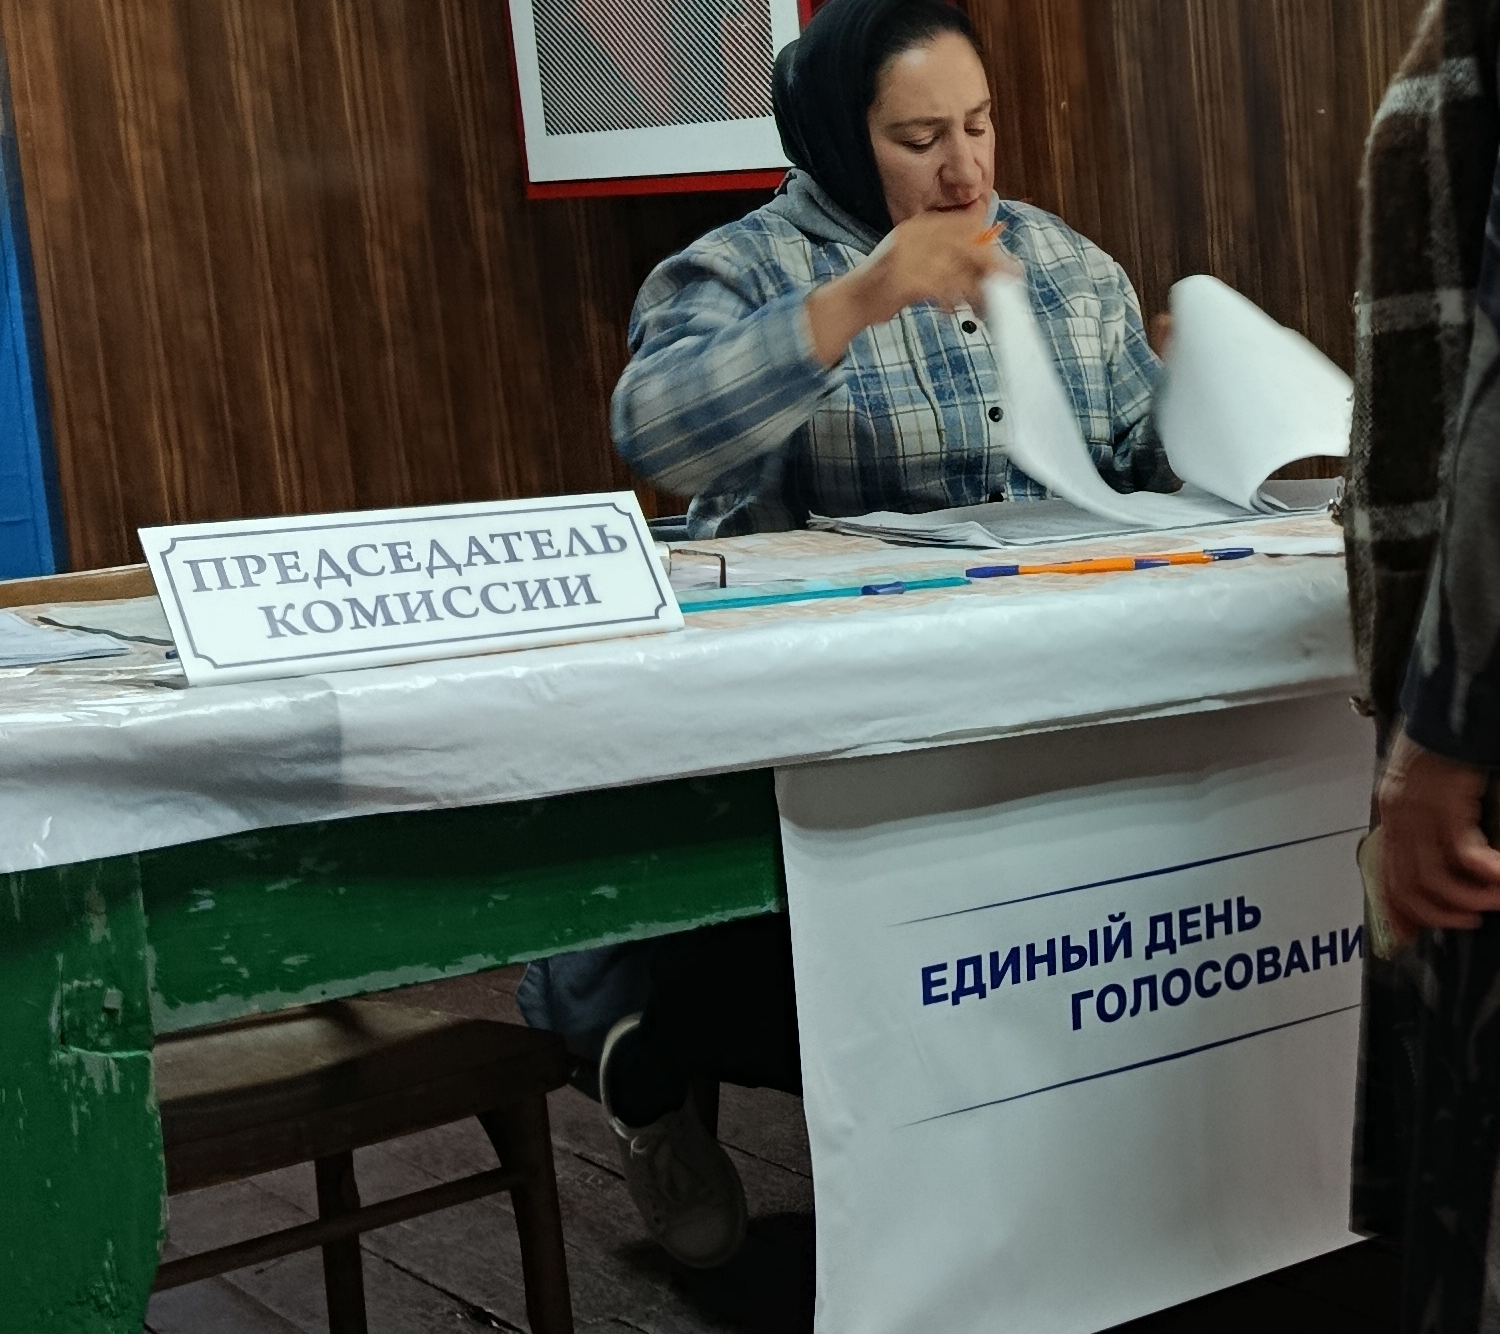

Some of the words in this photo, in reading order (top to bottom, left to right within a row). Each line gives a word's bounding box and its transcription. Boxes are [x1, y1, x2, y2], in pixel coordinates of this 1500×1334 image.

[184, 523, 628, 593] ПРЕДСЕДАТЕЛЬ
[258, 573, 602, 639] КОМИССИИ
[921, 912, 1133, 1007] ЕДИНЫЙ
[1145, 895, 1262, 960] ДЕНЬ
[1071, 924, 1364, 1031] ГОЛОСОВАНИ
